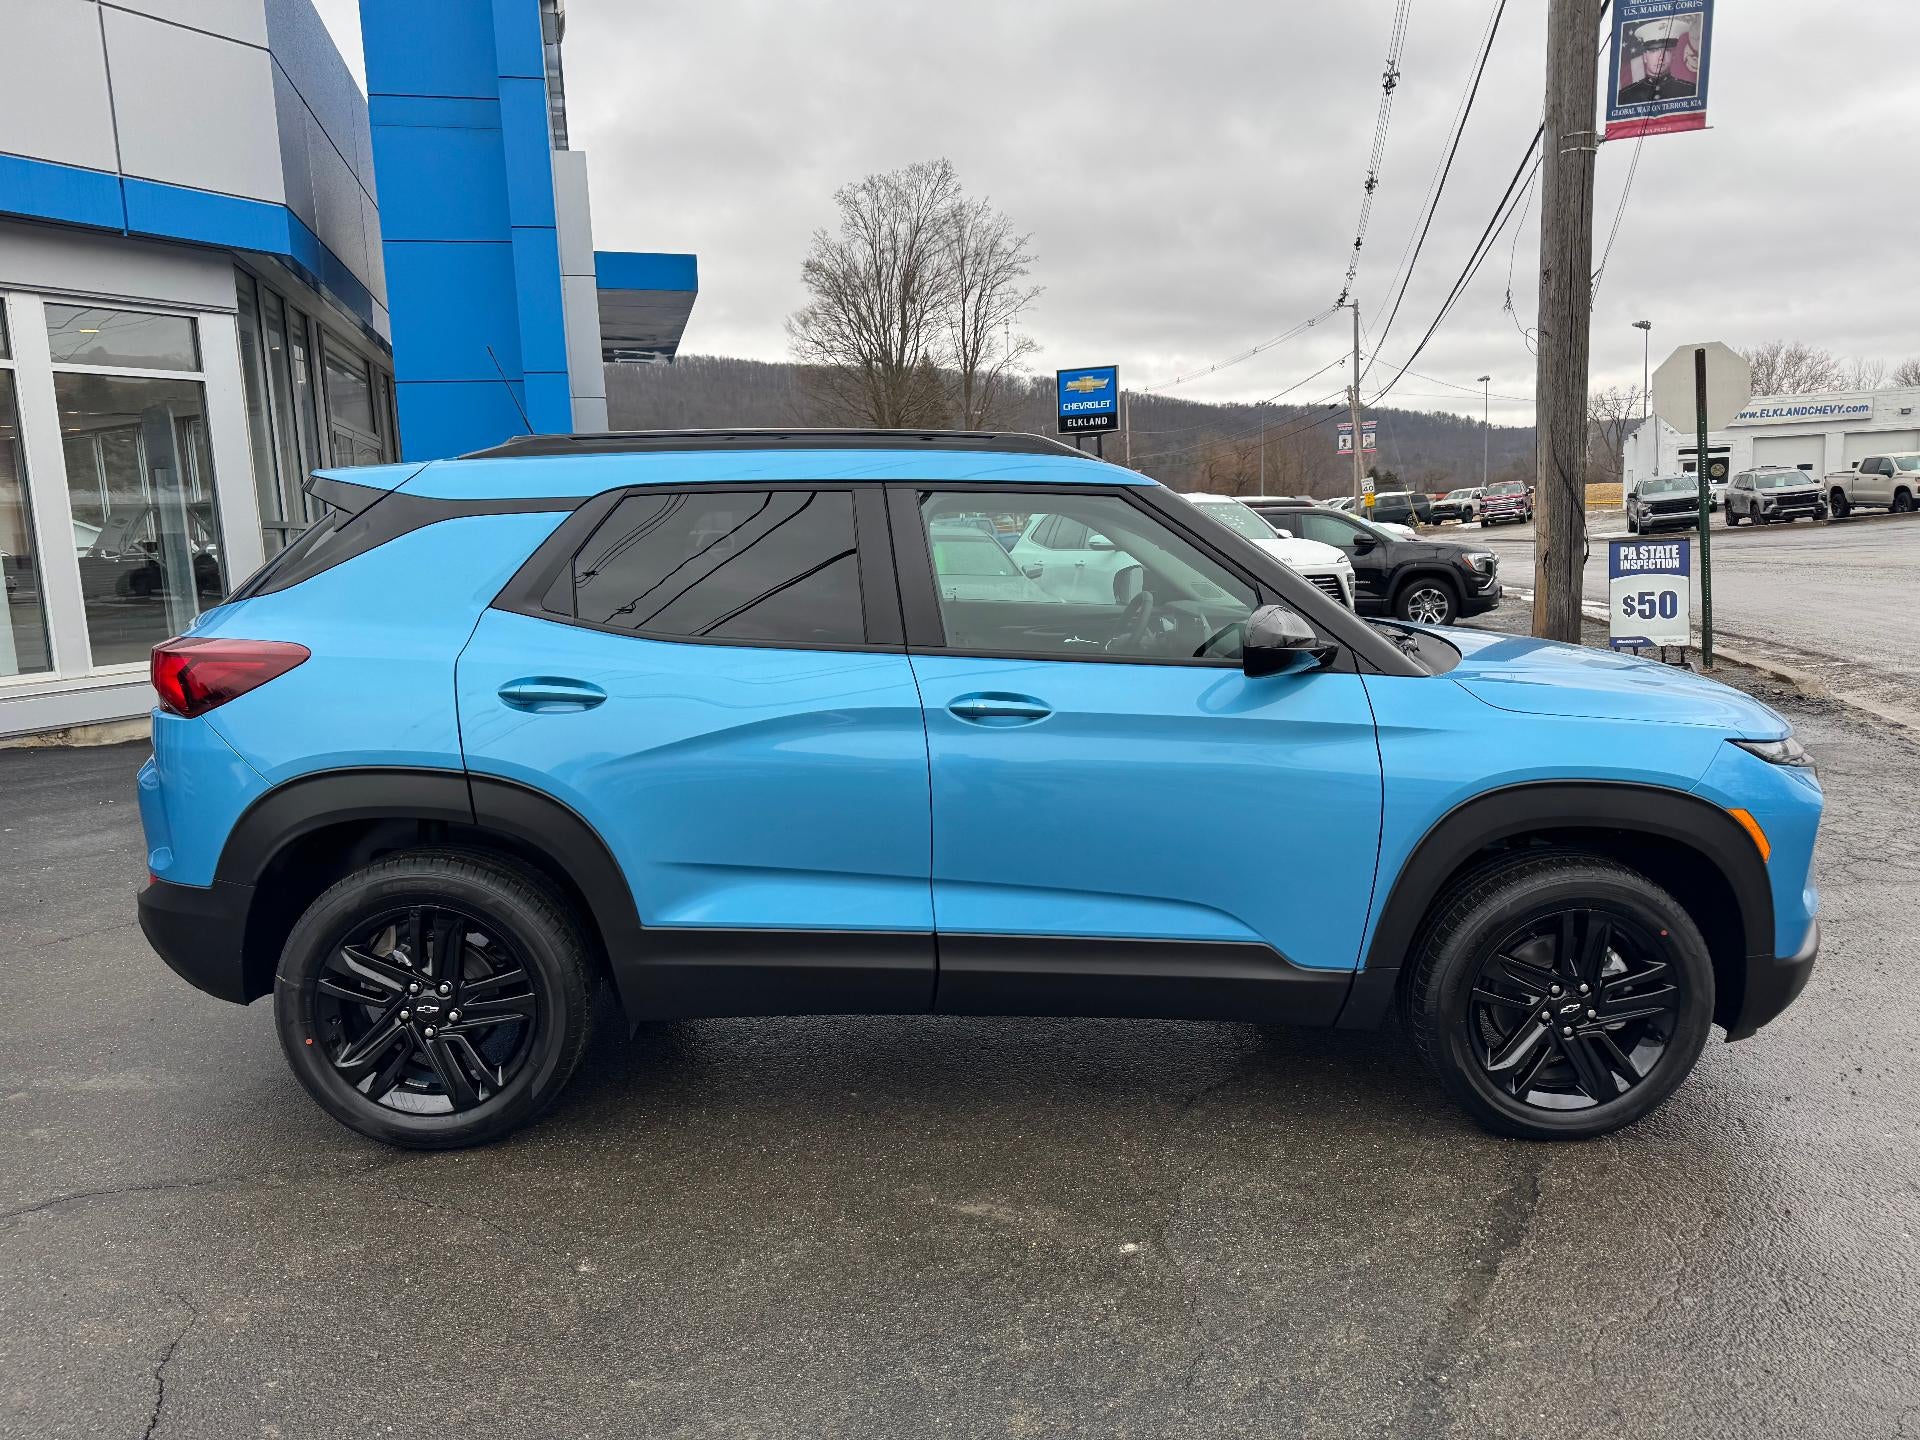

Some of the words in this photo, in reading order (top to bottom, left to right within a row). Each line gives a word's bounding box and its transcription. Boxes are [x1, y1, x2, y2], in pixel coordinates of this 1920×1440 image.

[1624, 8, 1638, 16] U.S.
[1640, 4, 1674, 14] MARINE
[1611, 108, 1636, 117] GLOBAL
[1063, 399, 1111, 411] CHEVROLET
[1067, 417, 1108, 427] ELKLAND
[1620, 547, 1637, 560] PA
[1639, 545, 1680, 559] STATE
[1620, 559, 1680, 570] INSPECTION
[1622, 590, 1678, 620] $50
